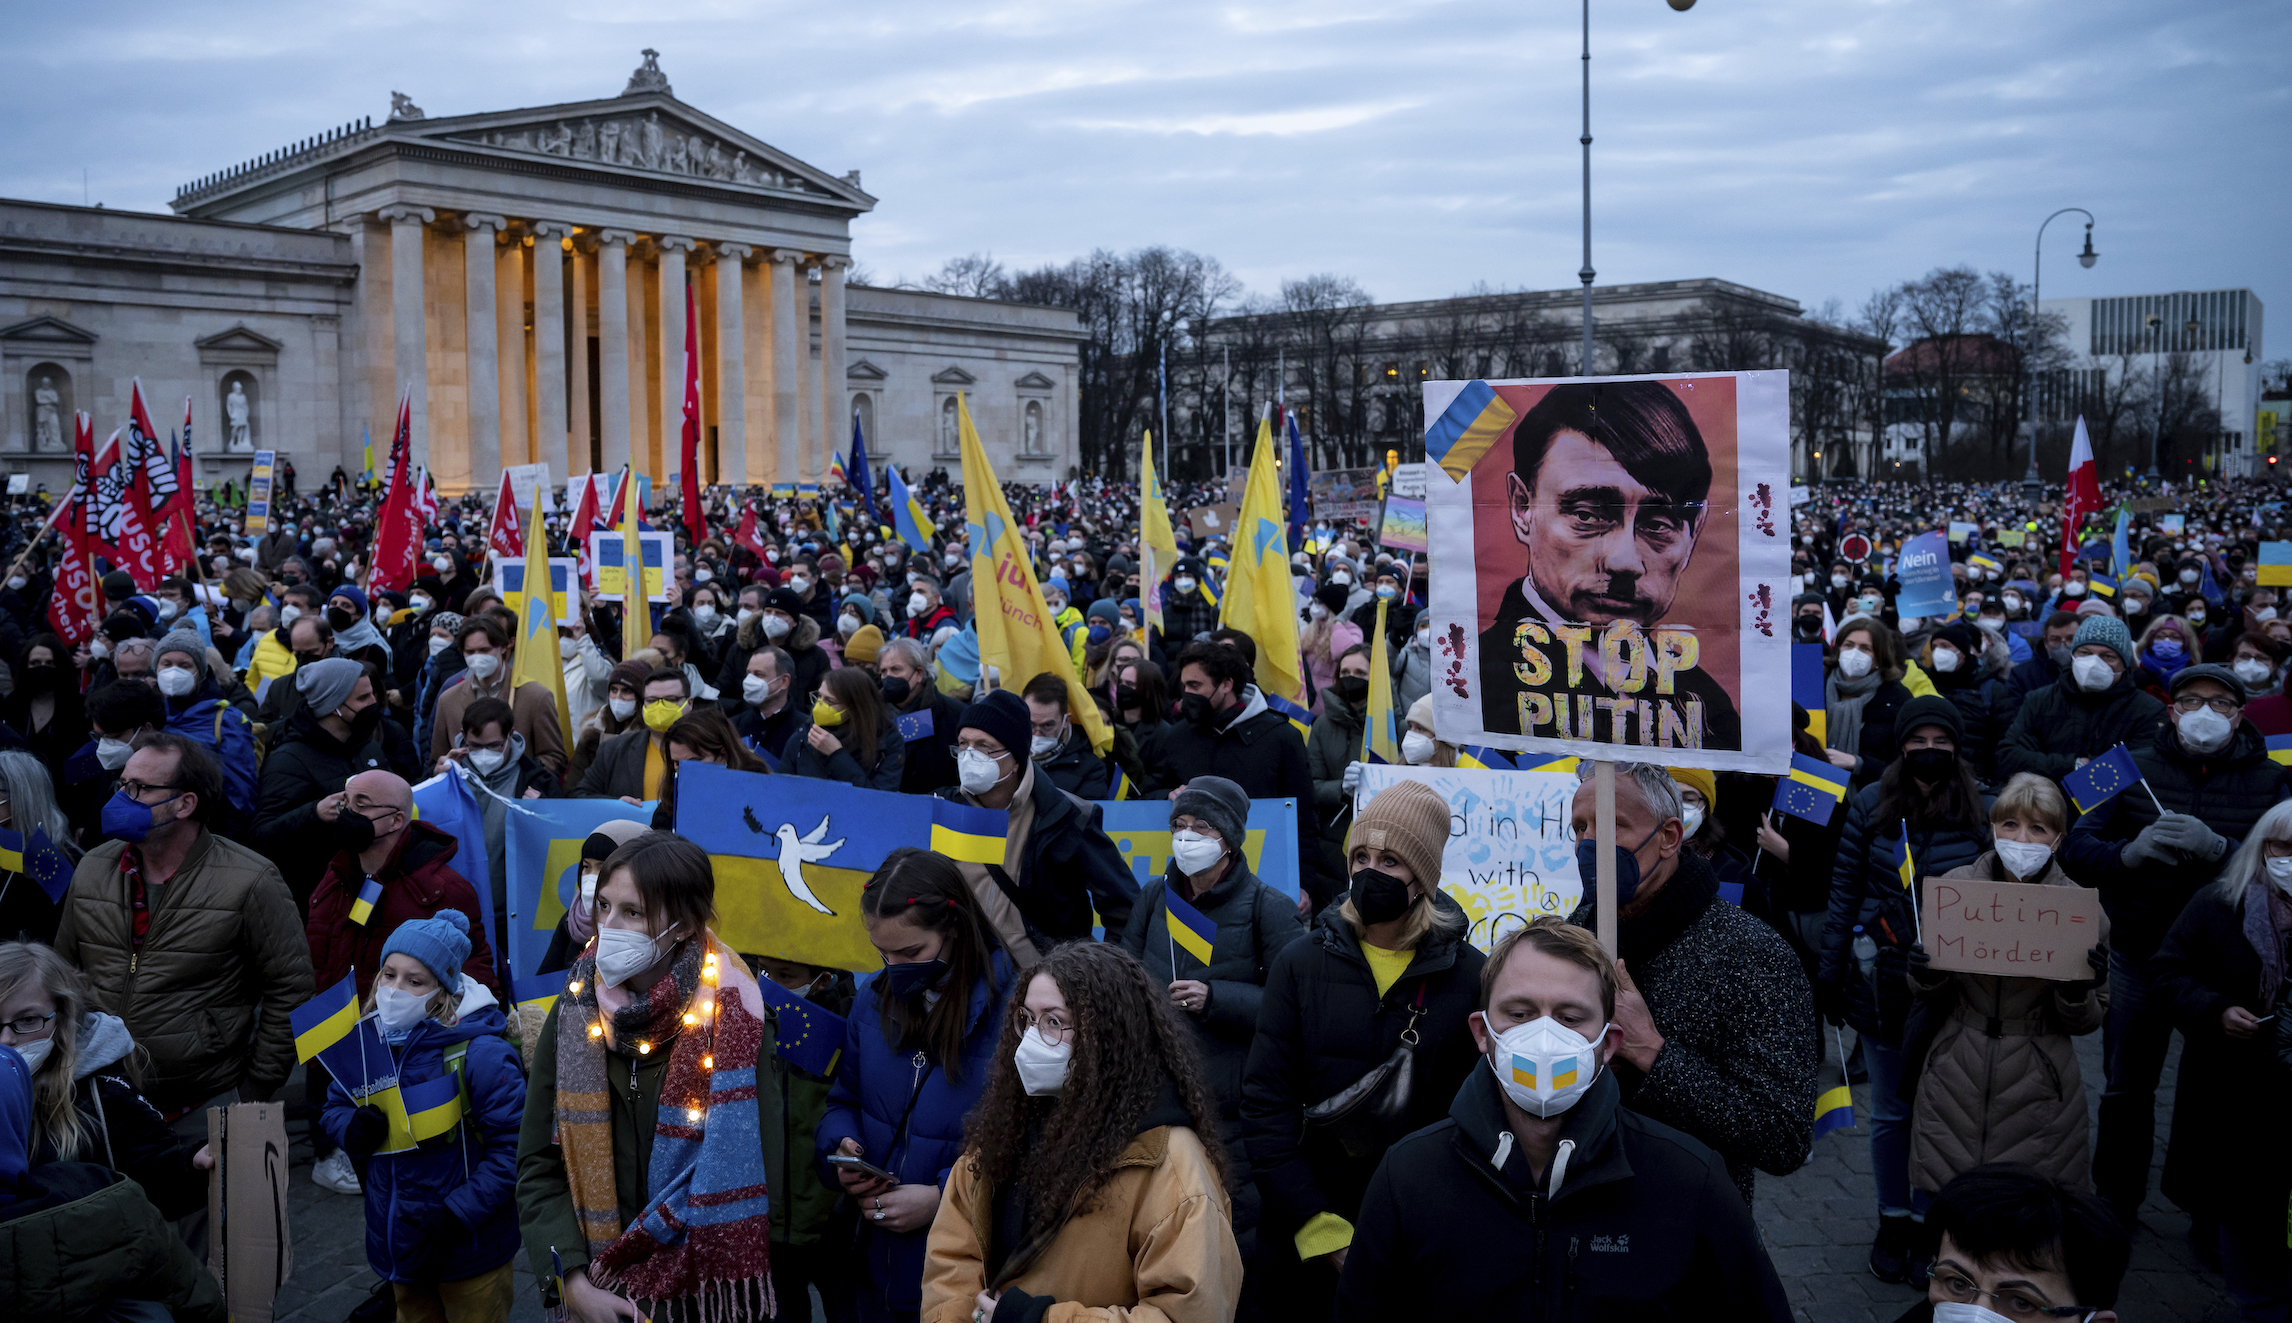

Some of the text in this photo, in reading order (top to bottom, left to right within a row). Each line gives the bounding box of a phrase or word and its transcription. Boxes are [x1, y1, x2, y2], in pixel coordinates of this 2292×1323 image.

[1902, 549, 1937, 569] Nein
[1916, 568, 1933, 576] Krieg
[1000, 596, 1043, 631] ünch
[1513, 618, 1700, 695] STOP
[1517, 691, 1703, 749] PUTIN
[1489, 807, 1518, 840] in
[1468, 860, 1540, 887] with
[1937, 934, 2056, 964] Mörder
[1590, 1234, 1613, 1243] Jack
[1590, 1243, 1630, 1253] Wolfskin
